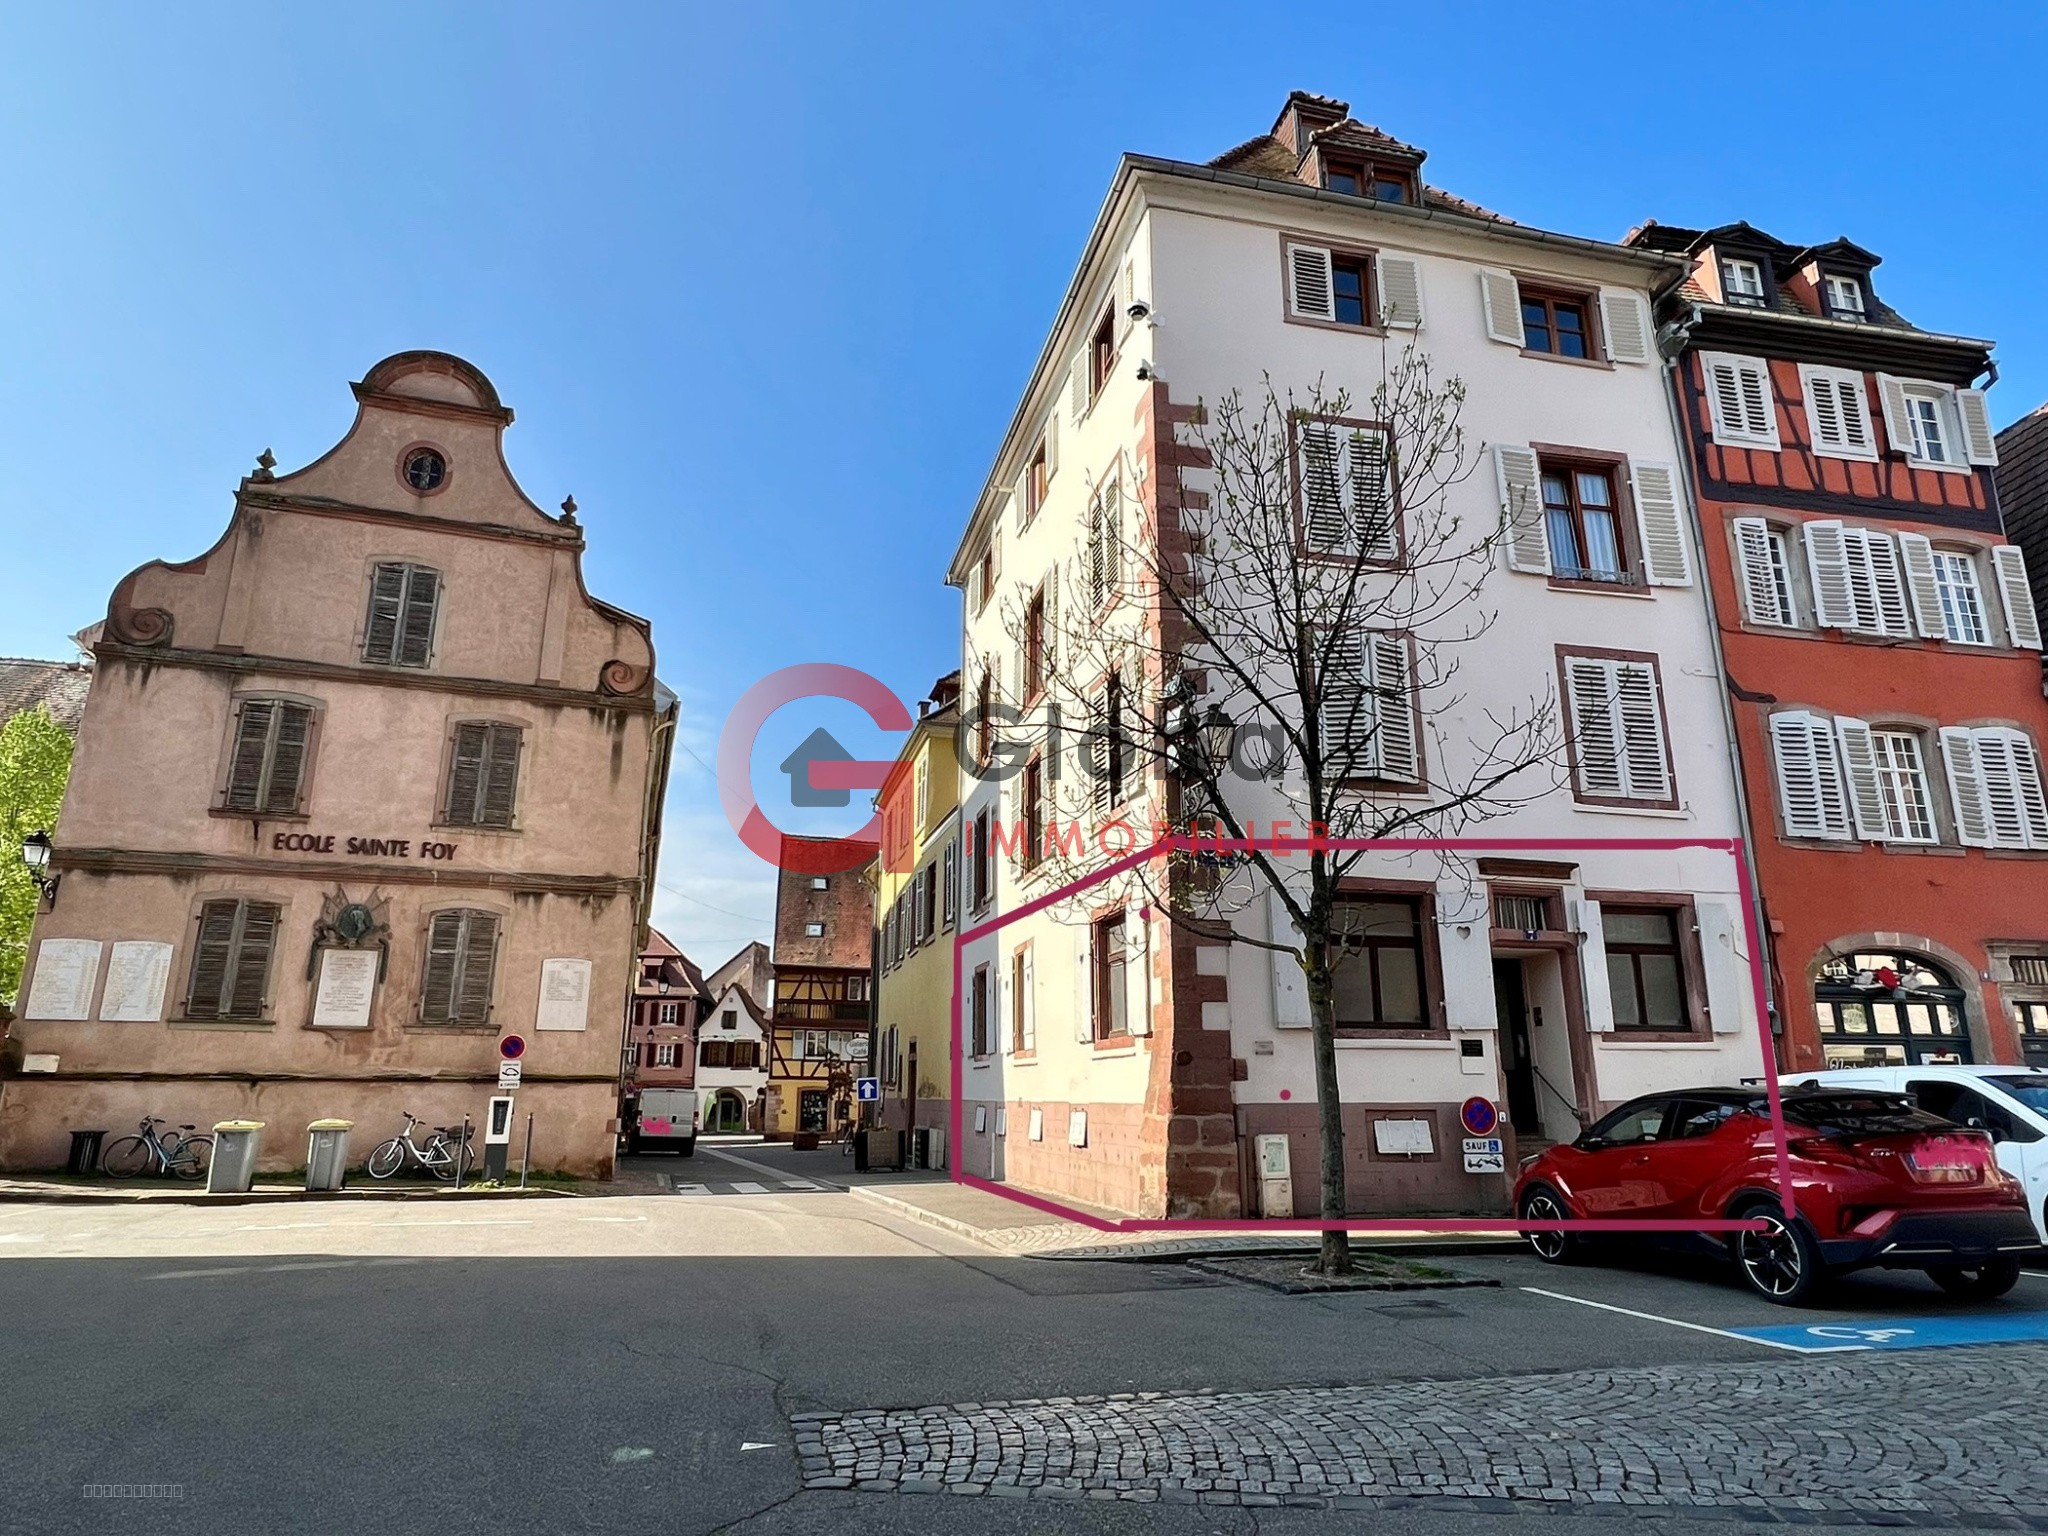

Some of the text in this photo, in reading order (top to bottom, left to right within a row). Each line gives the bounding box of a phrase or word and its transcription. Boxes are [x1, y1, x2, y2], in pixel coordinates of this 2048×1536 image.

[273, 833, 458, 861] ECOLE SAINTE FOY
[1465, 1141, 1487, 1151] SAUF
